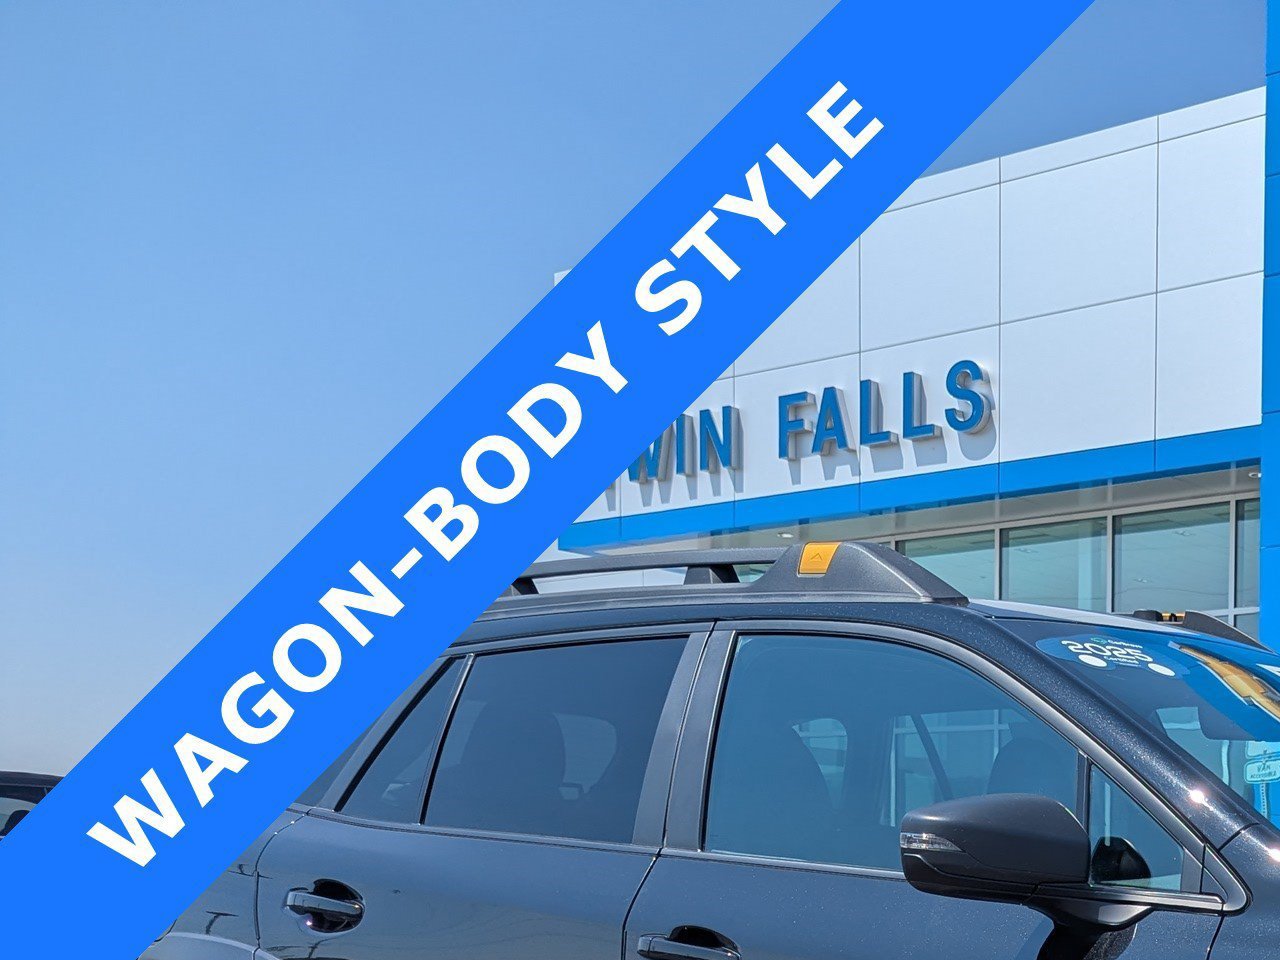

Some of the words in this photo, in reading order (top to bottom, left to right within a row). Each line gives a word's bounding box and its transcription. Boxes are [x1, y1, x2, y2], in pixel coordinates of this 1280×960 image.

[616, 403, 740, 484] WIN
[778, 359, 995, 460] FALLS
[1060, 640, 1154, 662] 2025
